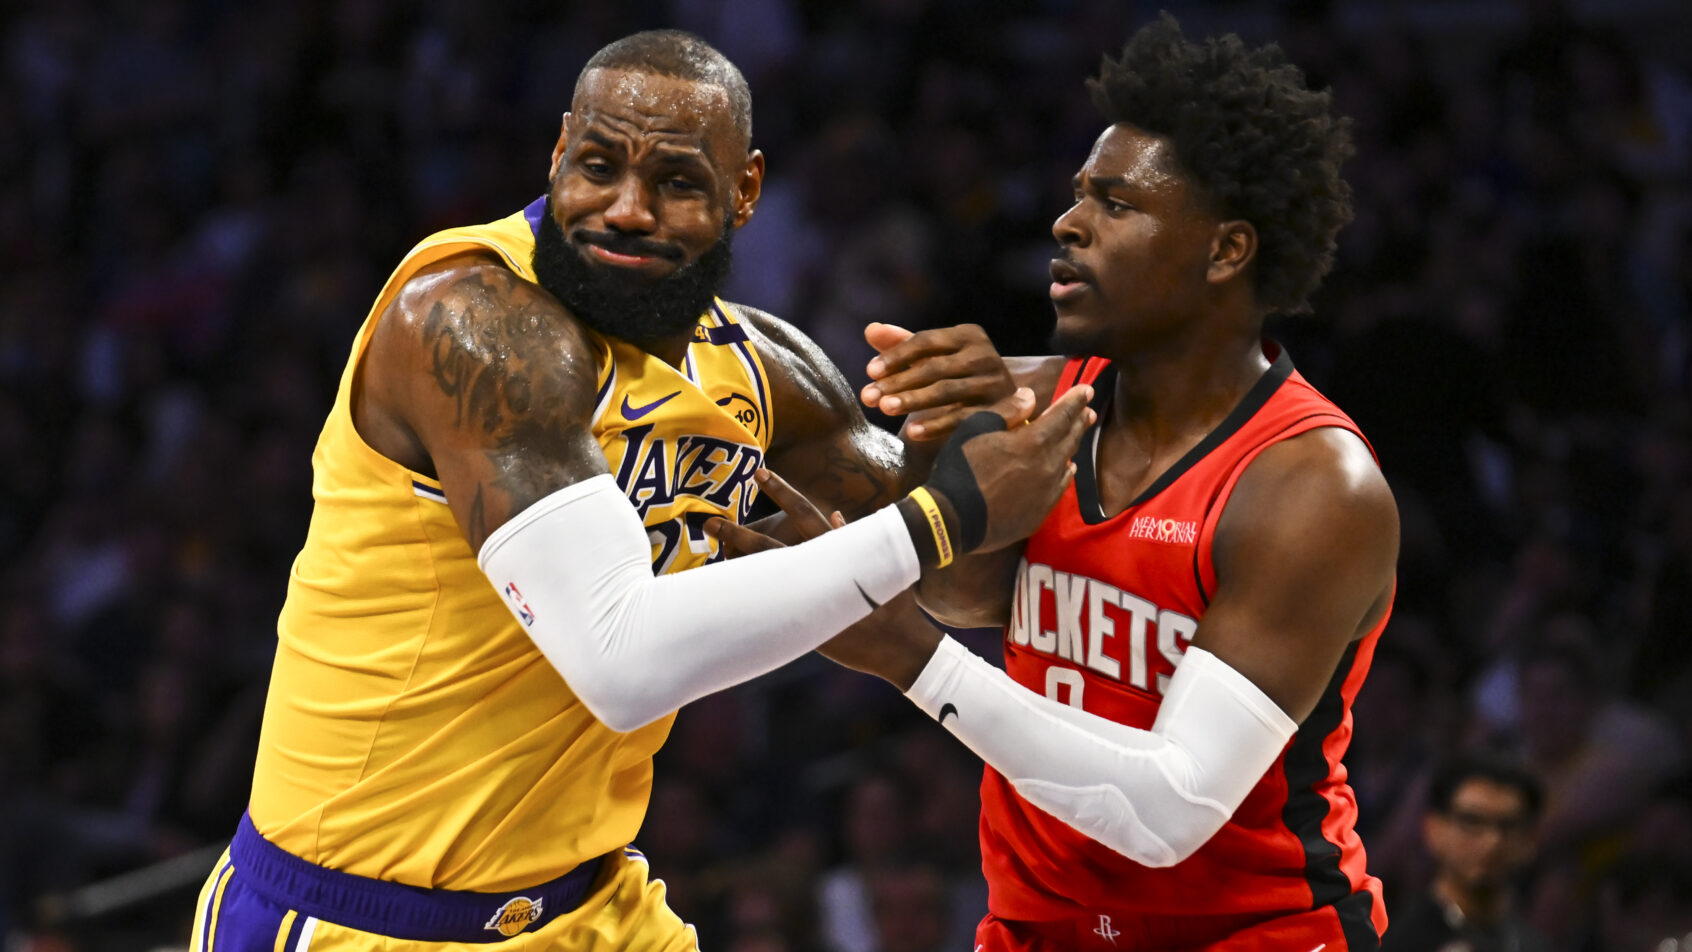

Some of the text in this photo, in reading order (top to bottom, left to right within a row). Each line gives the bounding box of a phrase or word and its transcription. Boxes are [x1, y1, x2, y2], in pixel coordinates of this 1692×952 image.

[1128, 525, 1196, 543] HERMANN
[1132, 516, 1197, 535] MEMORIAL
[1007, 555, 1198, 697] OCKETS
